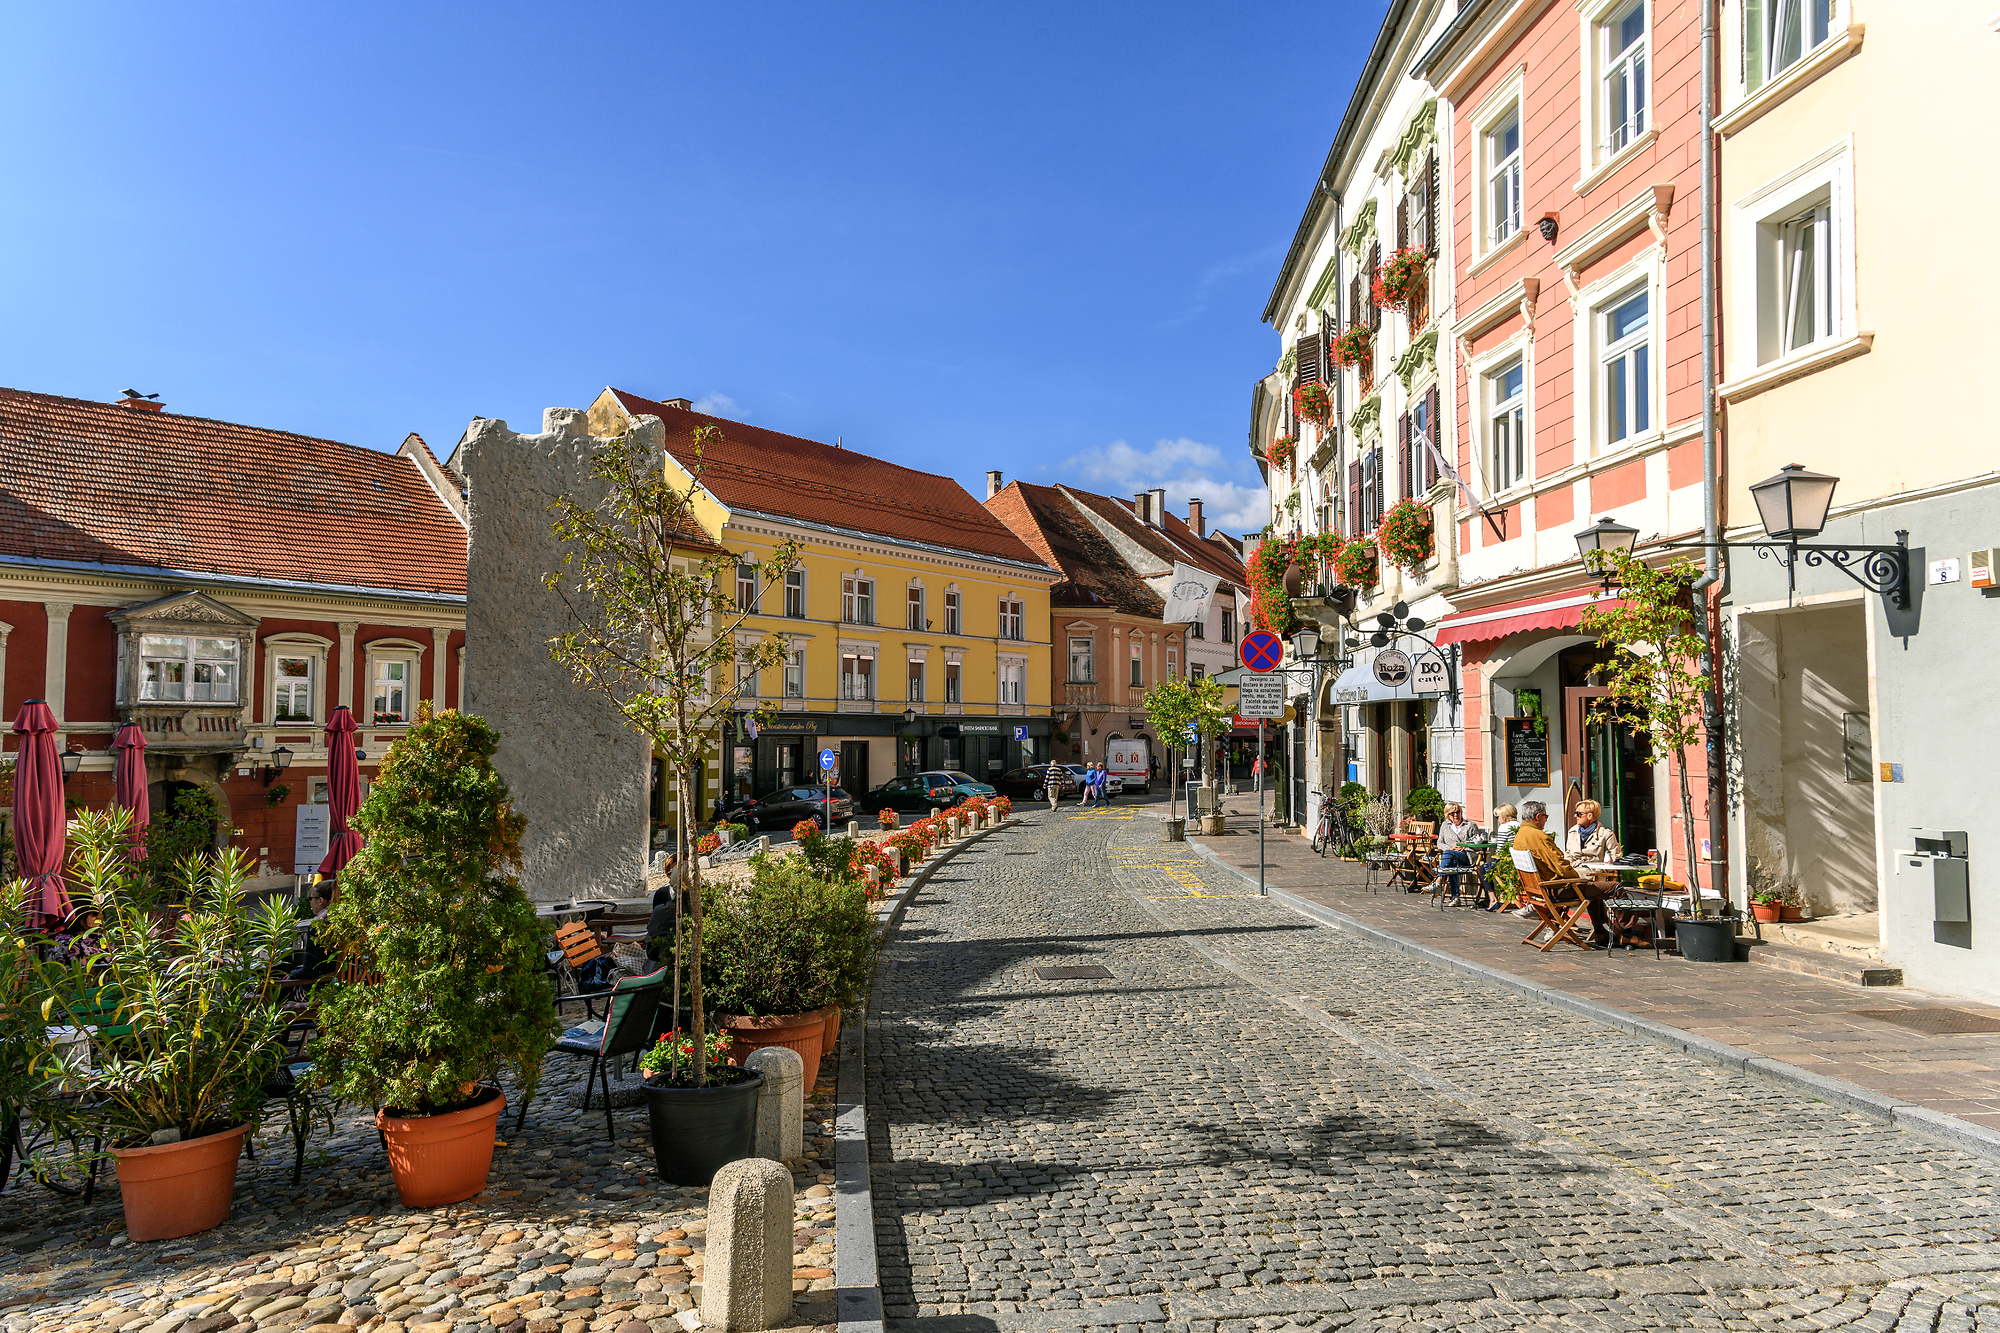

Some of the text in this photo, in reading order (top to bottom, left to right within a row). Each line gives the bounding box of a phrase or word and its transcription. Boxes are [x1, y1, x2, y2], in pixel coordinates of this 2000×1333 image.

[1941, 571, 1947, 582] 8
[1380, 662, 1405, 672] Roža
[1420, 662, 1441, 674] BO
[1016, 728, 1022, 738] P
